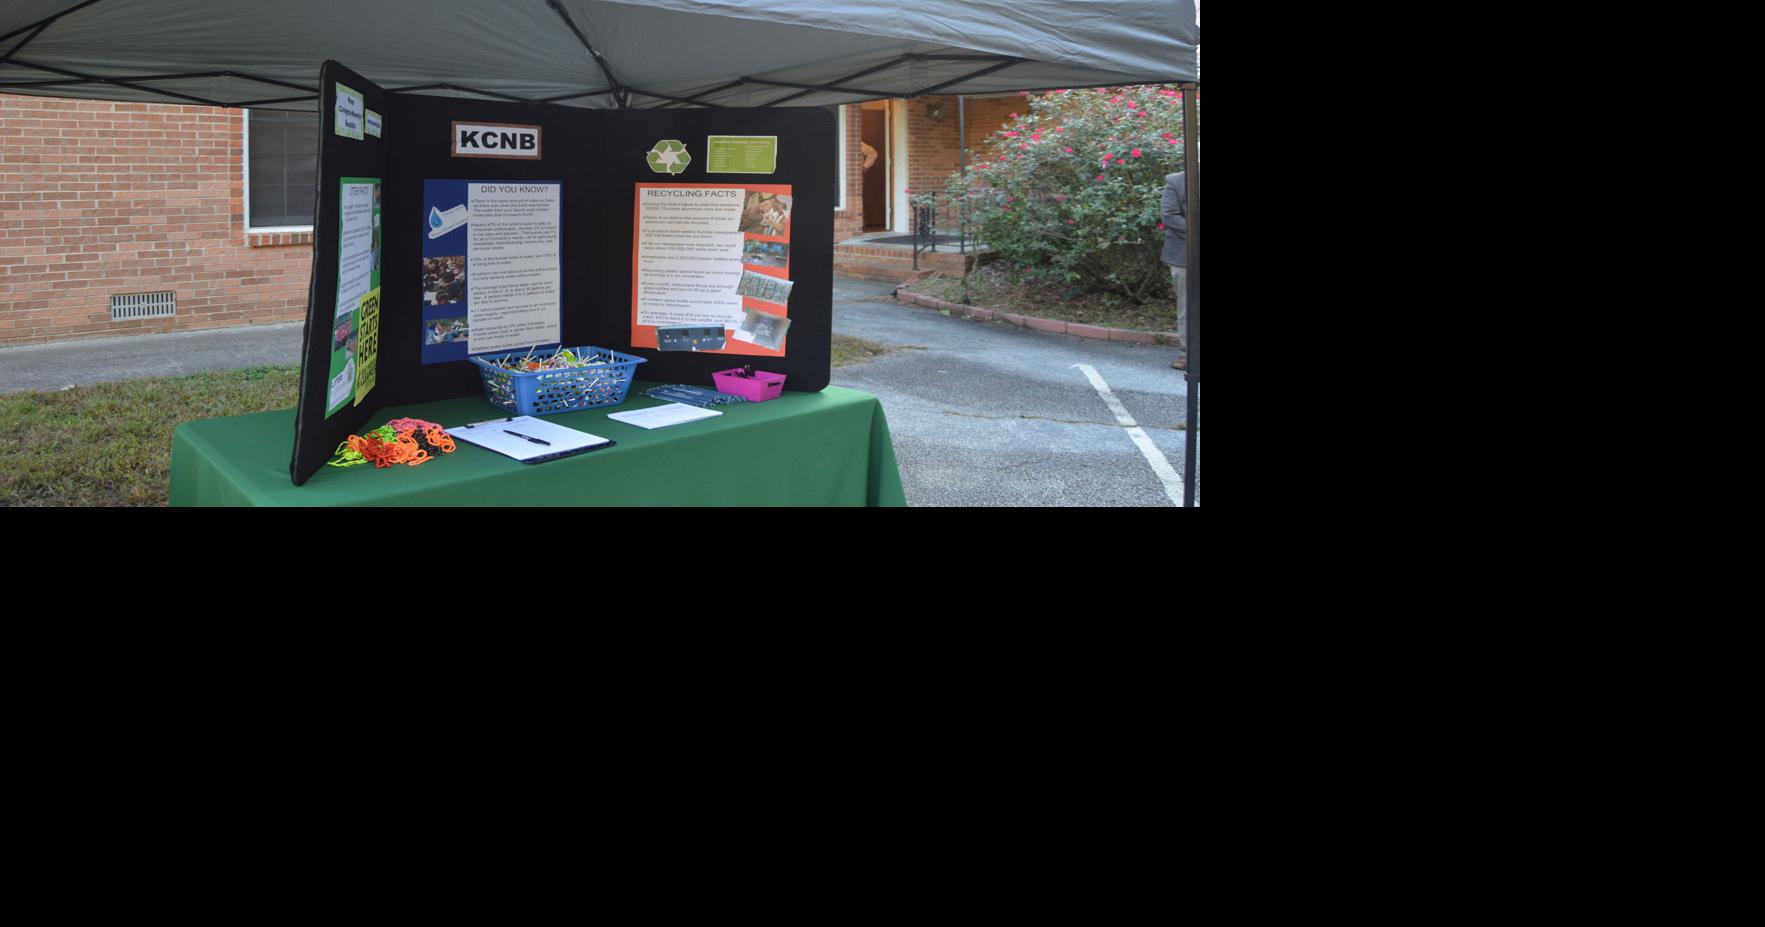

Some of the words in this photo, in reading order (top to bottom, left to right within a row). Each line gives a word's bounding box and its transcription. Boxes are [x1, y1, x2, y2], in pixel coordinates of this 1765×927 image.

[460, 130, 536, 150] KCNB
[647, 189, 702, 198] RECYCLING
[361, 294, 378, 321] GREEN
[360, 314, 378, 342] STARTS
[359, 332, 377, 367] HERE
